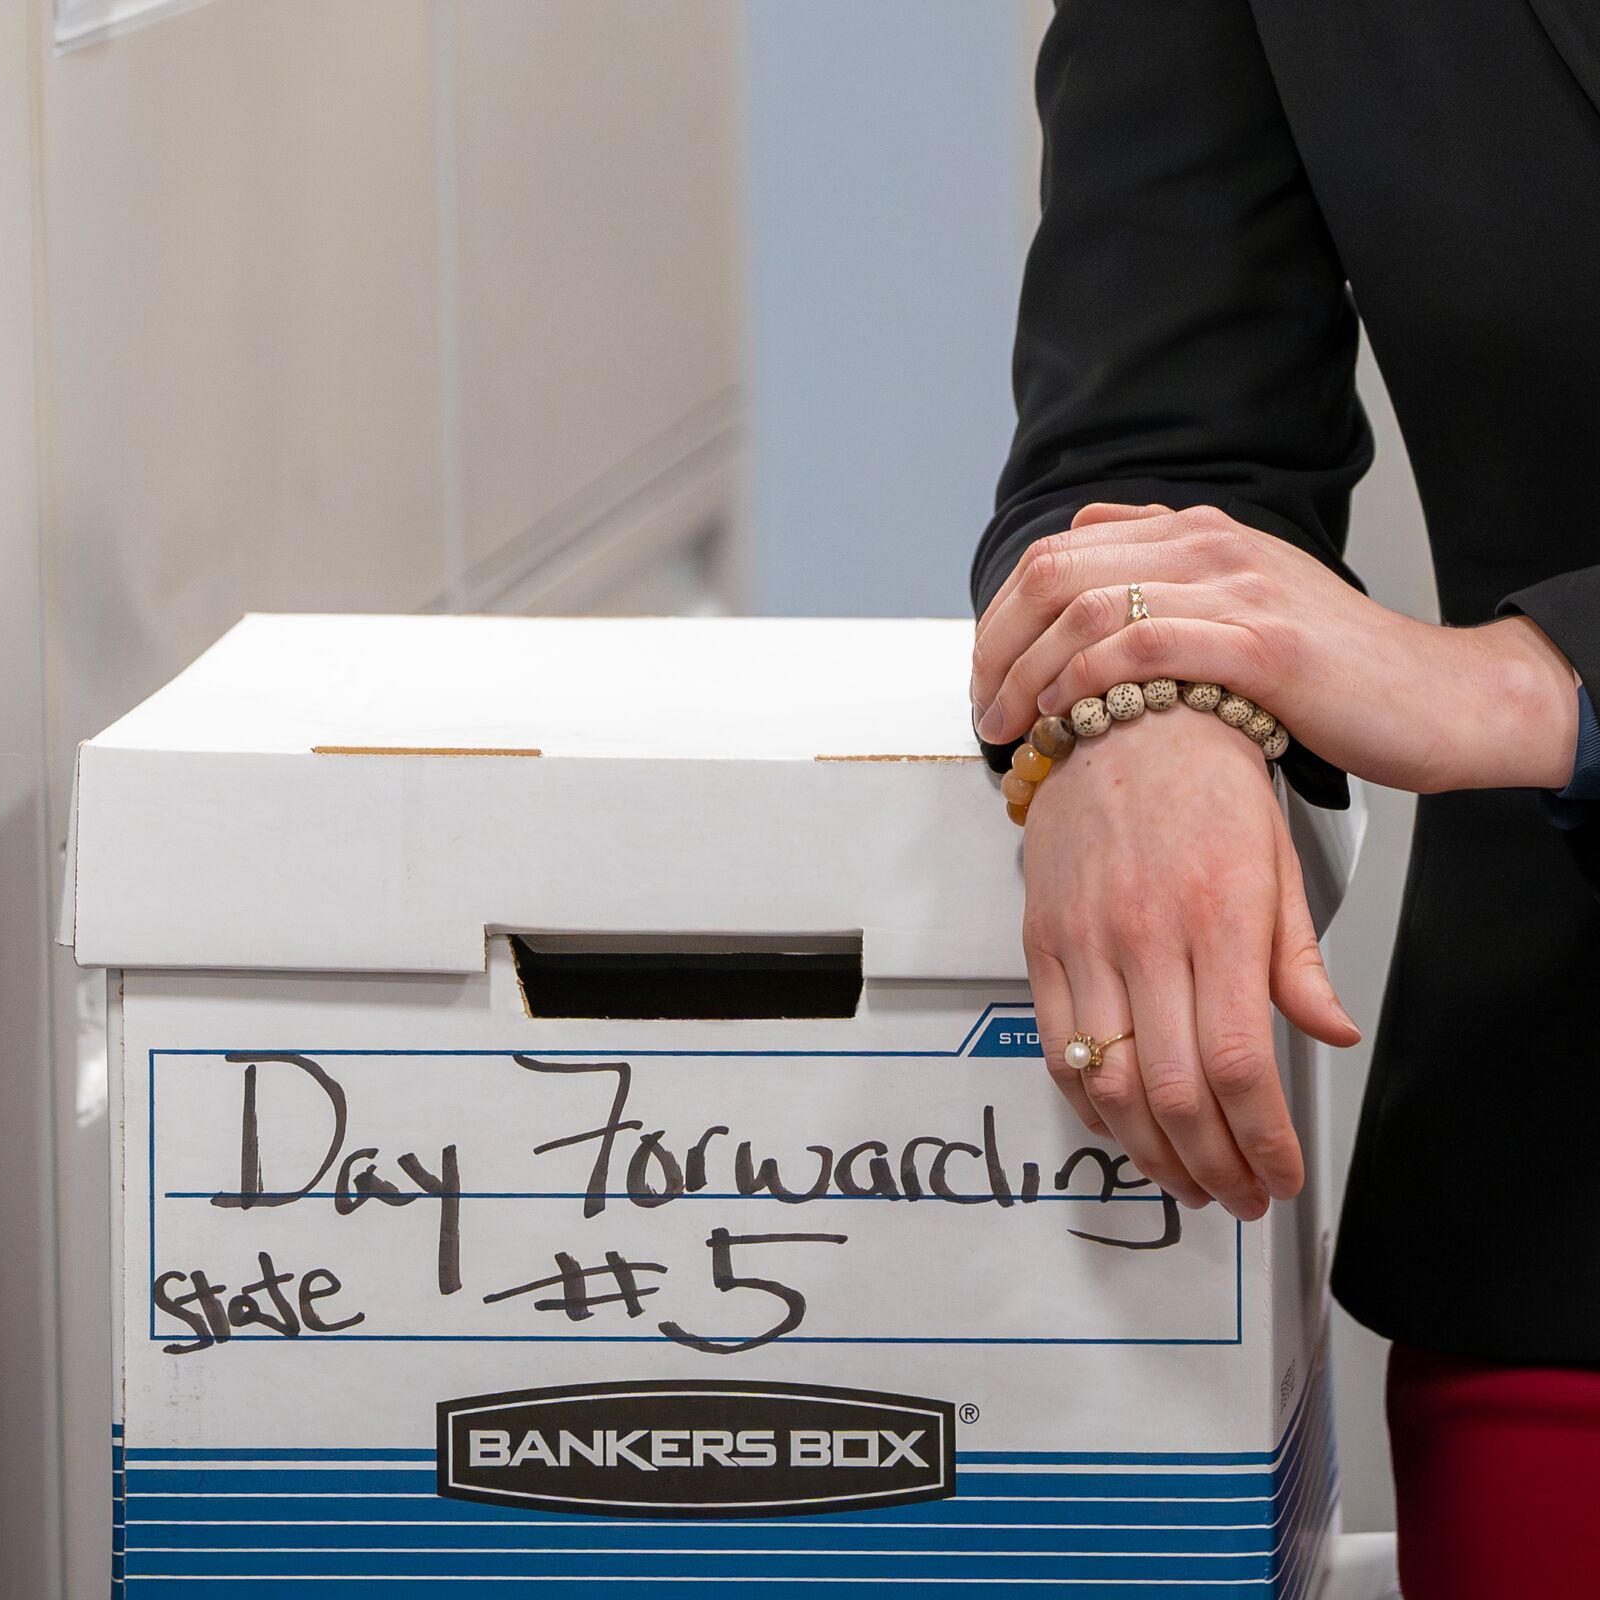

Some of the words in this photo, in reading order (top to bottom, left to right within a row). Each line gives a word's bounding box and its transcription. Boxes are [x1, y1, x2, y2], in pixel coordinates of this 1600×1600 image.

[999, 1031, 1040, 1045] STO
[210, 1051, 463, 1295] Day
[513, 1052, 1181, 1250] Forwarding
[482, 1227, 848, 1354] #5
[469, 1429, 776, 1472] BANKERS
[790, 1429, 930, 1468] BOX
